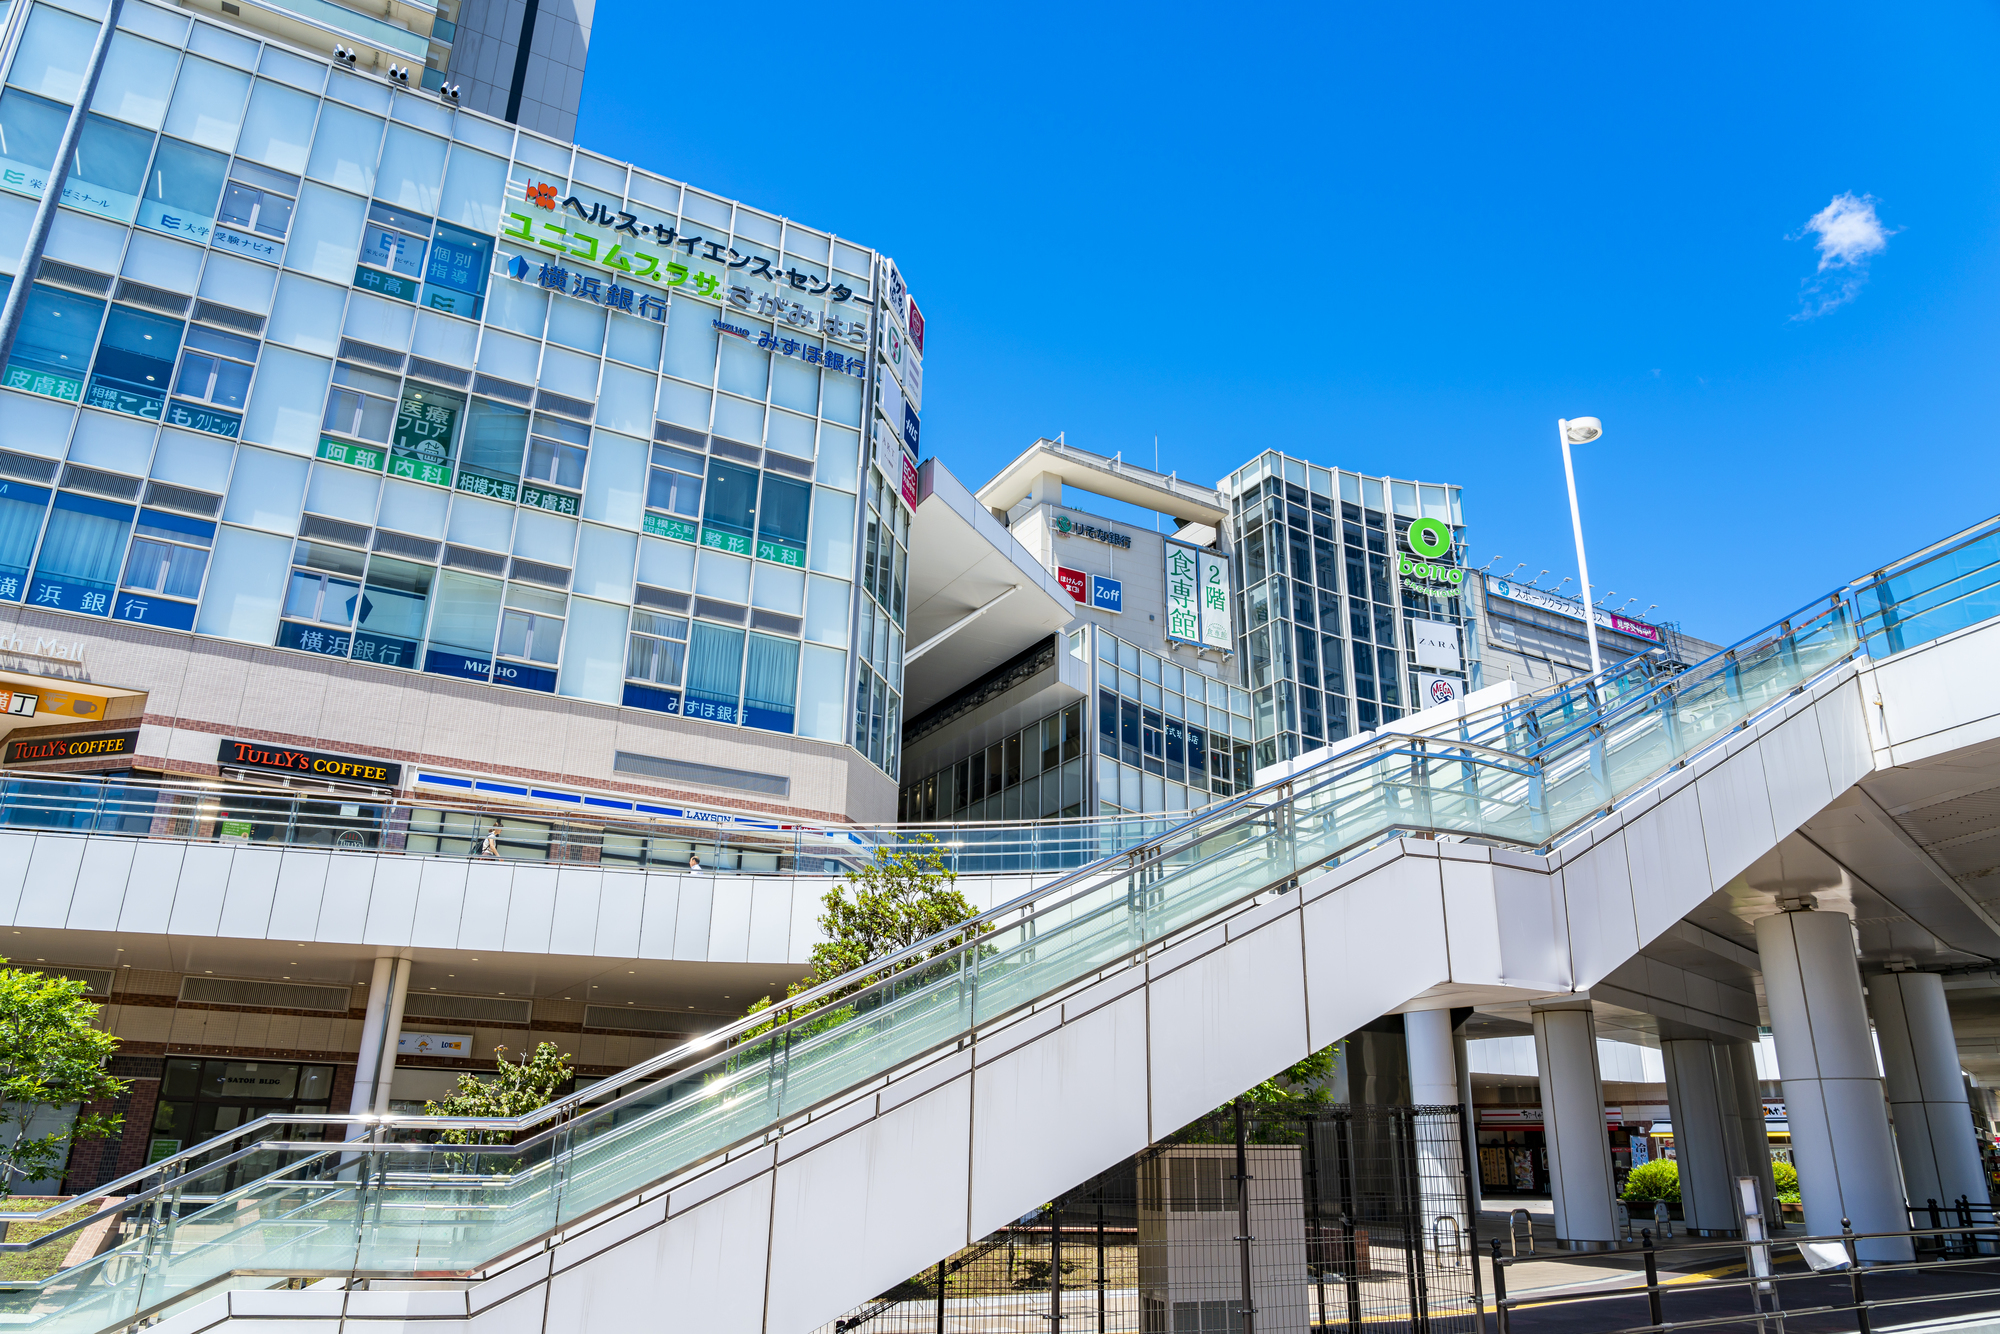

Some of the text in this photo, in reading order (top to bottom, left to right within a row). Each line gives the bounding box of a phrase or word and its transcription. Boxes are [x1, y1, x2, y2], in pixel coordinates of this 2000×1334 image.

[184, 222, 275, 256] 大学受験ナビオ
[562, 196, 874, 307] ヘルス・サイエンス・センター
[434, 245, 471, 269] 個別
[362, 272, 402, 295] 中高
[430, 261, 469, 286] 指導
[538, 262, 667, 323] 横浜銀行
[711, 318, 867, 379] MIZUHO みずほ銀行
[7, 369, 79, 402] 皮膚科
[91, 386, 118, 401] 相模
[90, 397, 115, 411] 大野
[400, 399, 450, 427] 医療
[397, 413, 449, 439] フロア
[326, 442, 443, 485] 阿部内科
[643, 515, 696, 536] 相模大野
[1075, 522, 1132, 549] りそな銀行
[704, 531, 798, 567] 整形外科
[1397, 551, 1464, 585] bono
[1060, 575, 1084, 588] ほけんの
[1095, 586, 1120, 602] Zoff
[1168, 548, 1198, 640] 食専館
[1205, 564, 1226, 613] 2階
[1404, 578, 1462, 599] SAGAMIONO
[0, 576, 149, 620] 横浜銀行
[1514, 587, 1571, 612] スポーツクラブ
[34, 636, 85, 663] Mall
[299, 629, 402, 666] 横浜銀行
[1418, 638, 1457, 651] ZARA
[463, 659, 519, 680] MIZHO
[1433, 682, 1453, 697] MEGA
[667, 697, 750, 725] みずほ銀行
[14, 739, 126, 760] TULLY'S COFFEE
[234, 742, 388, 782] TULLY'S COFFEE
[686, 809, 732, 823] LAWSON
[227, 1076, 256, 1084] SATOH
